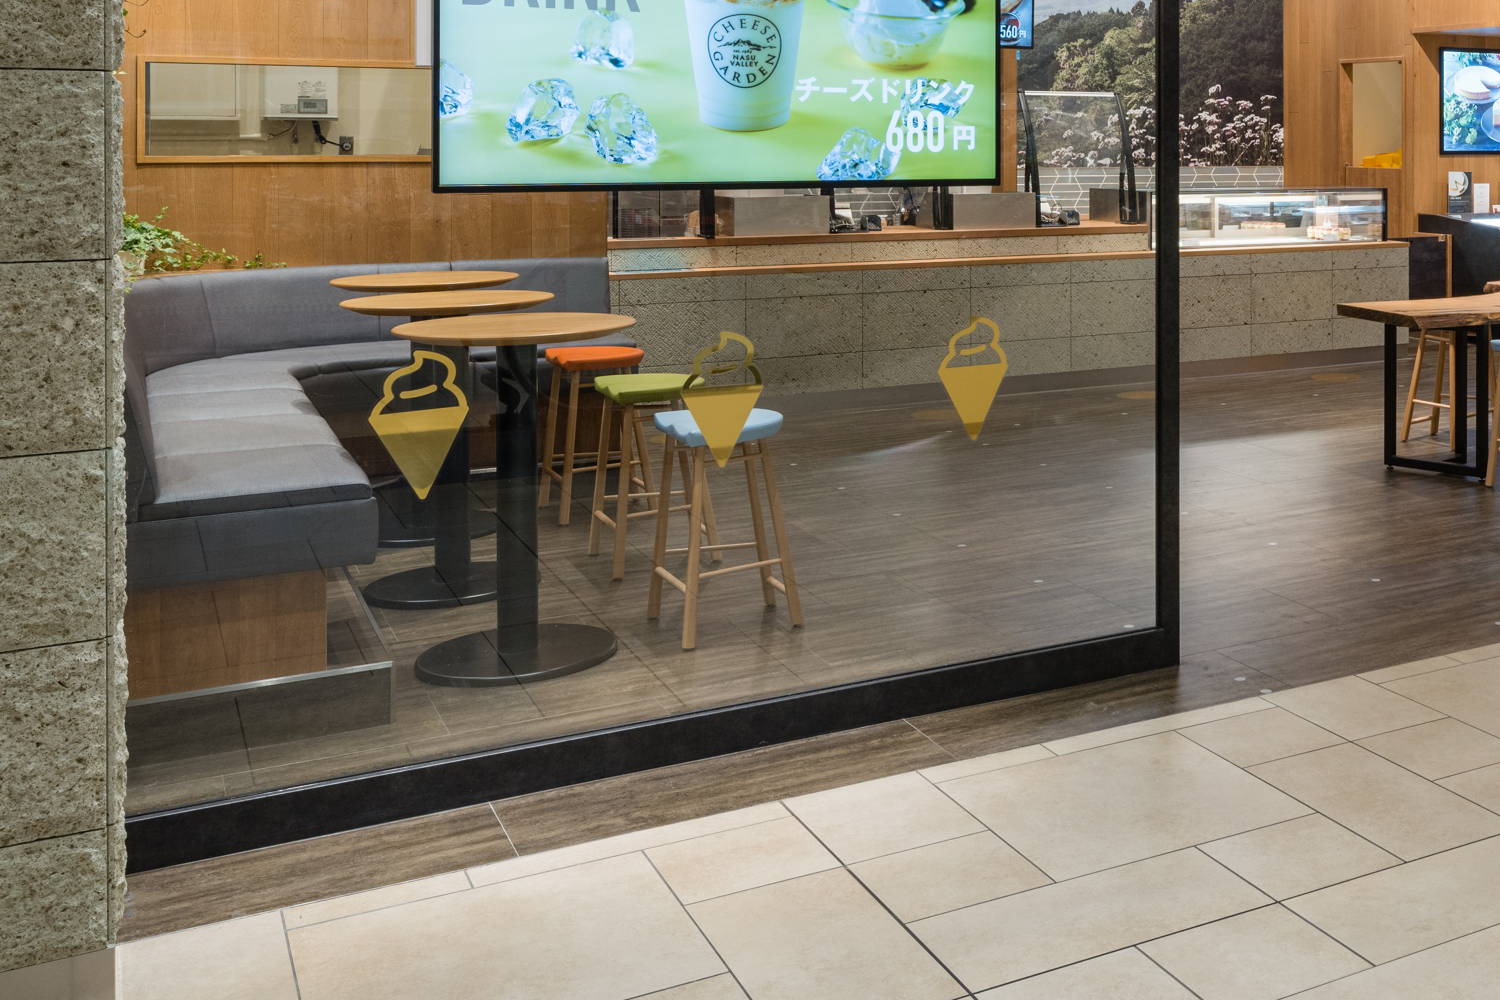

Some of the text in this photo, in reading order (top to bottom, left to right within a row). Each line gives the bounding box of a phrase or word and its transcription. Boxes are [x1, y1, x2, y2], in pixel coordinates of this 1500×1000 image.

[713, 19, 776, 43] CHEESE
[713, 51, 776, 83] GARDEN
[796, 77, 975, 104] チーズドリンク
